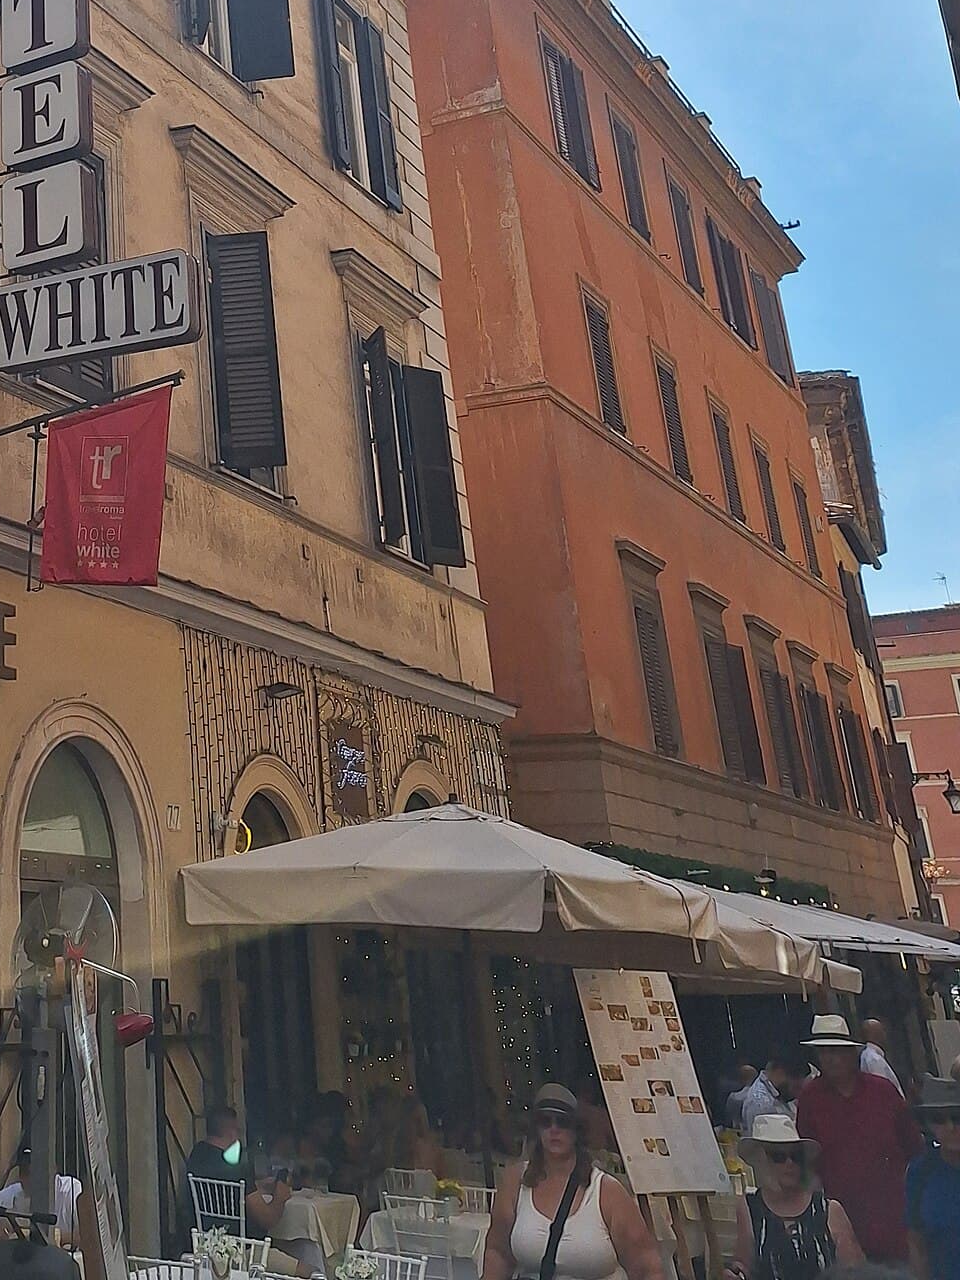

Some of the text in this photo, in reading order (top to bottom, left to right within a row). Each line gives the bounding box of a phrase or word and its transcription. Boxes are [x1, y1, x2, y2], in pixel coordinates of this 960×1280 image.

[89, 445, 123, 489] tr
[77, 523, 122, 542] hotel
[76, 541, 121, 559] white
